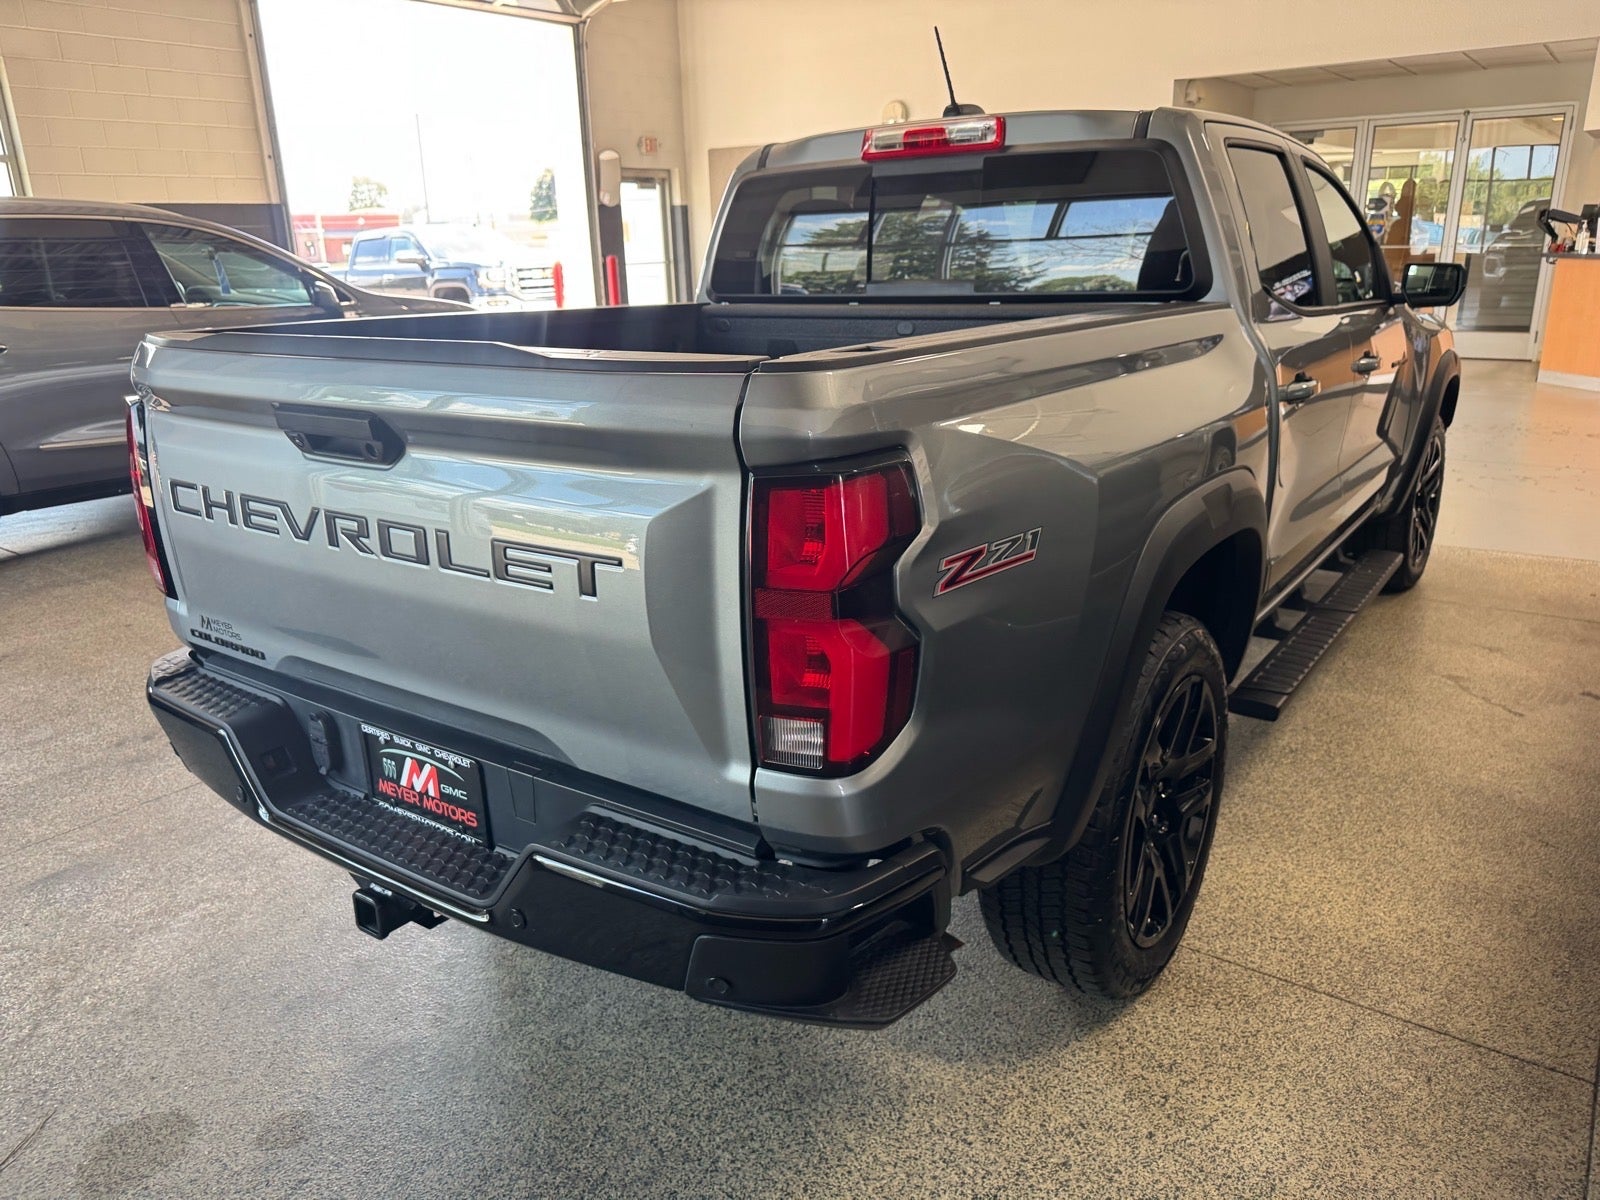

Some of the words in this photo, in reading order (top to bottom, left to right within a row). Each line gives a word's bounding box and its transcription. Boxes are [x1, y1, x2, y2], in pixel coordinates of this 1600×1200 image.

[169, 478, 624, 600] CHEVROLET
[932, 527, 1042, 598] Z71
[190, 628, 266, 660] COLORADO
[213, 627, 242, 640] MOTORS
[360, 723, 391, 740] CERTIFIED
[393, 734, 413, 749] BUICK
[415, 742, 432, 755] GMC
[434, 749, 471, 768] CHEVROLET
[378, 777, 421, 807] MEYER
[423, 795, 478, 828] MOTORS
[440, 783, 468, 800] GMC
